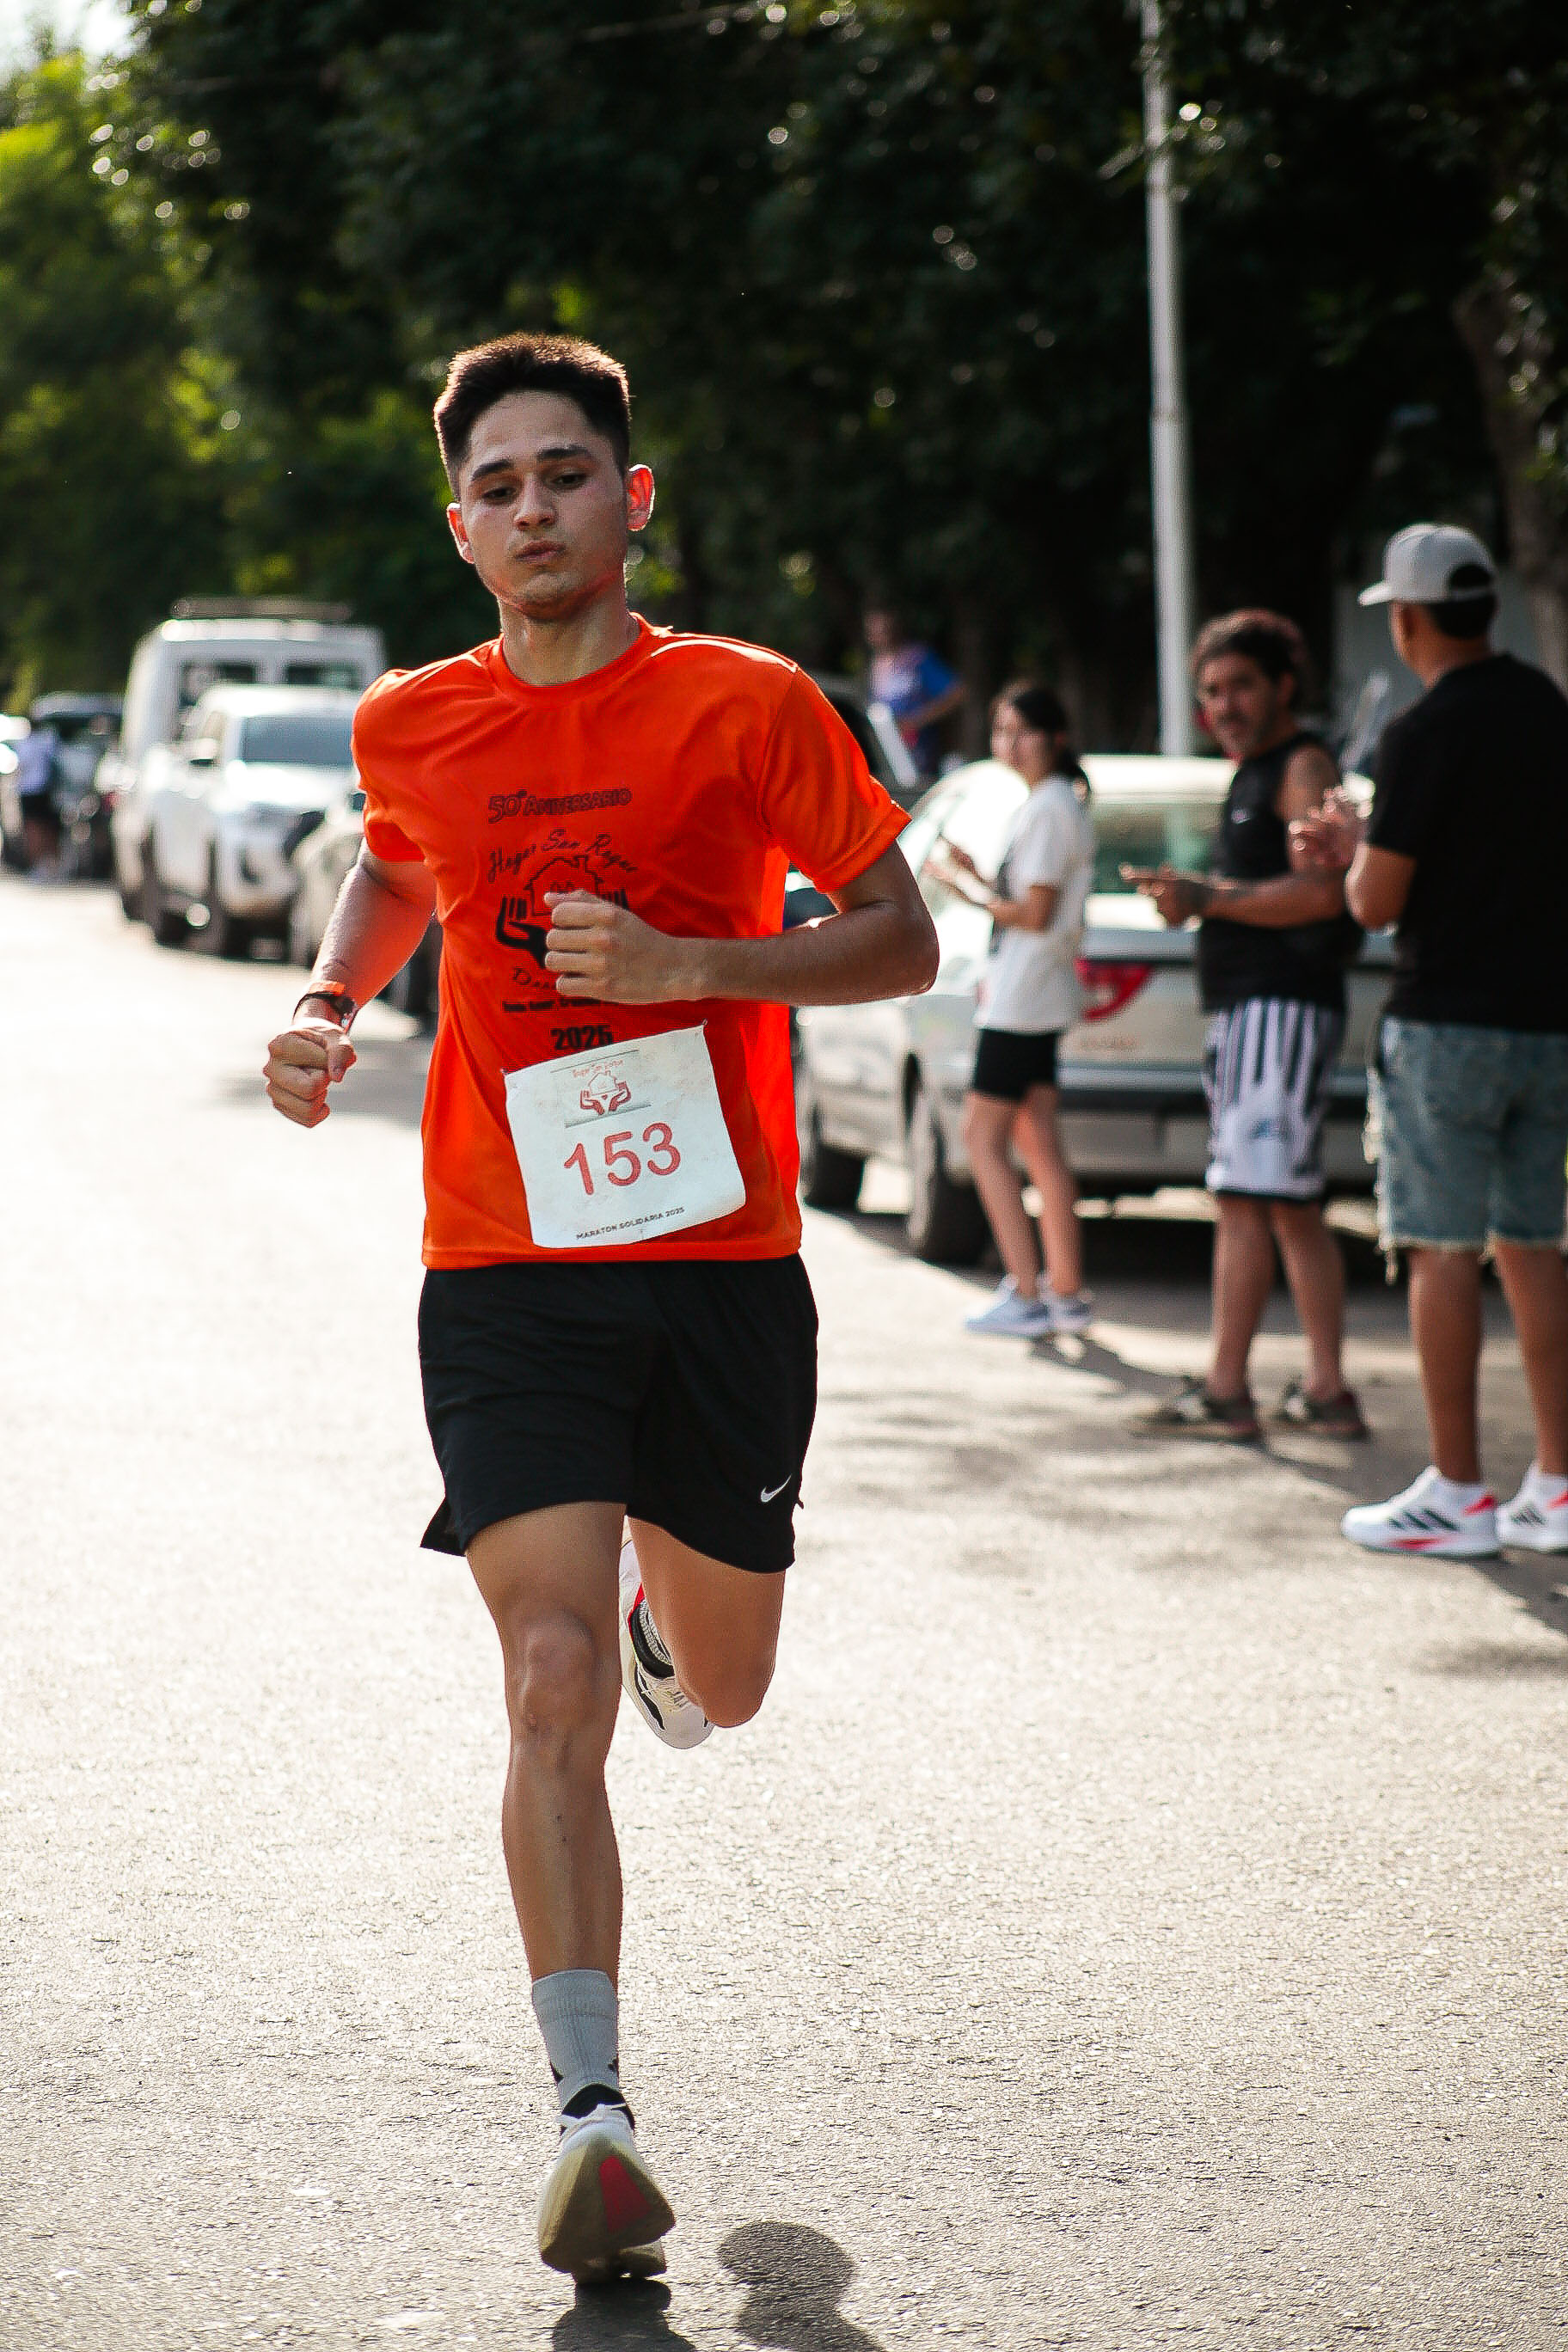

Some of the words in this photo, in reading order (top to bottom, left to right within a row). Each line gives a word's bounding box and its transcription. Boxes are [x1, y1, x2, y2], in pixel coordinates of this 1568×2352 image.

[542, 828, 581, 851] San
[551, 1024, 614, 1050] 2025
[563, 1122, 682, 1196] 153
[576, 1224, 618, 1240] MARATON
[618, 1212, 665, 1229] SOLIDARIA
[665, 1206, 686, 1217] 2025
